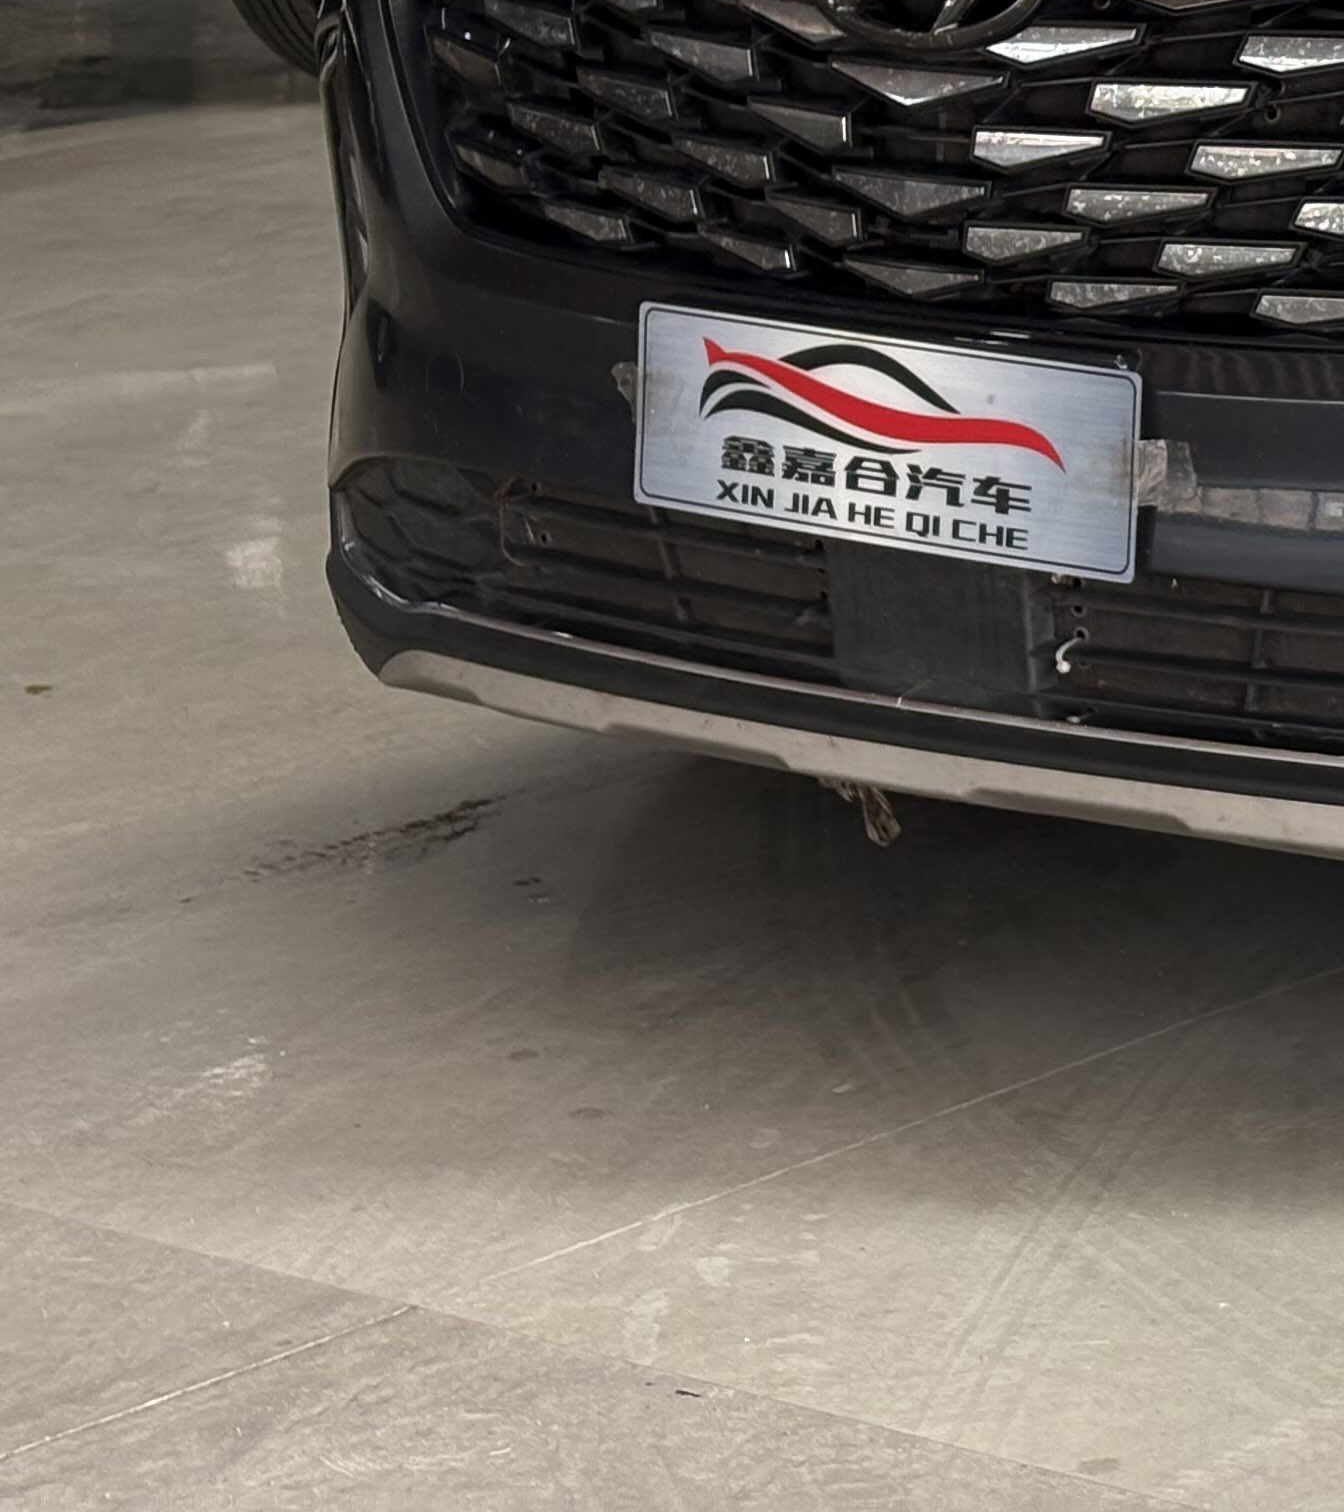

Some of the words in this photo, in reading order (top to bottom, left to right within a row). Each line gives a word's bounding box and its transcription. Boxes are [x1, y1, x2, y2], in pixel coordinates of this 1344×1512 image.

[721, 435, 1033, 515] 鑫嘉合汽车
[716, 479, 775, 509] XIN
[784, 492, 838, 520] JIA
[847, 501, 896, 529] HE
[905, 511, 941, 539] QI
[951, 519, 1030, 551] CHE
